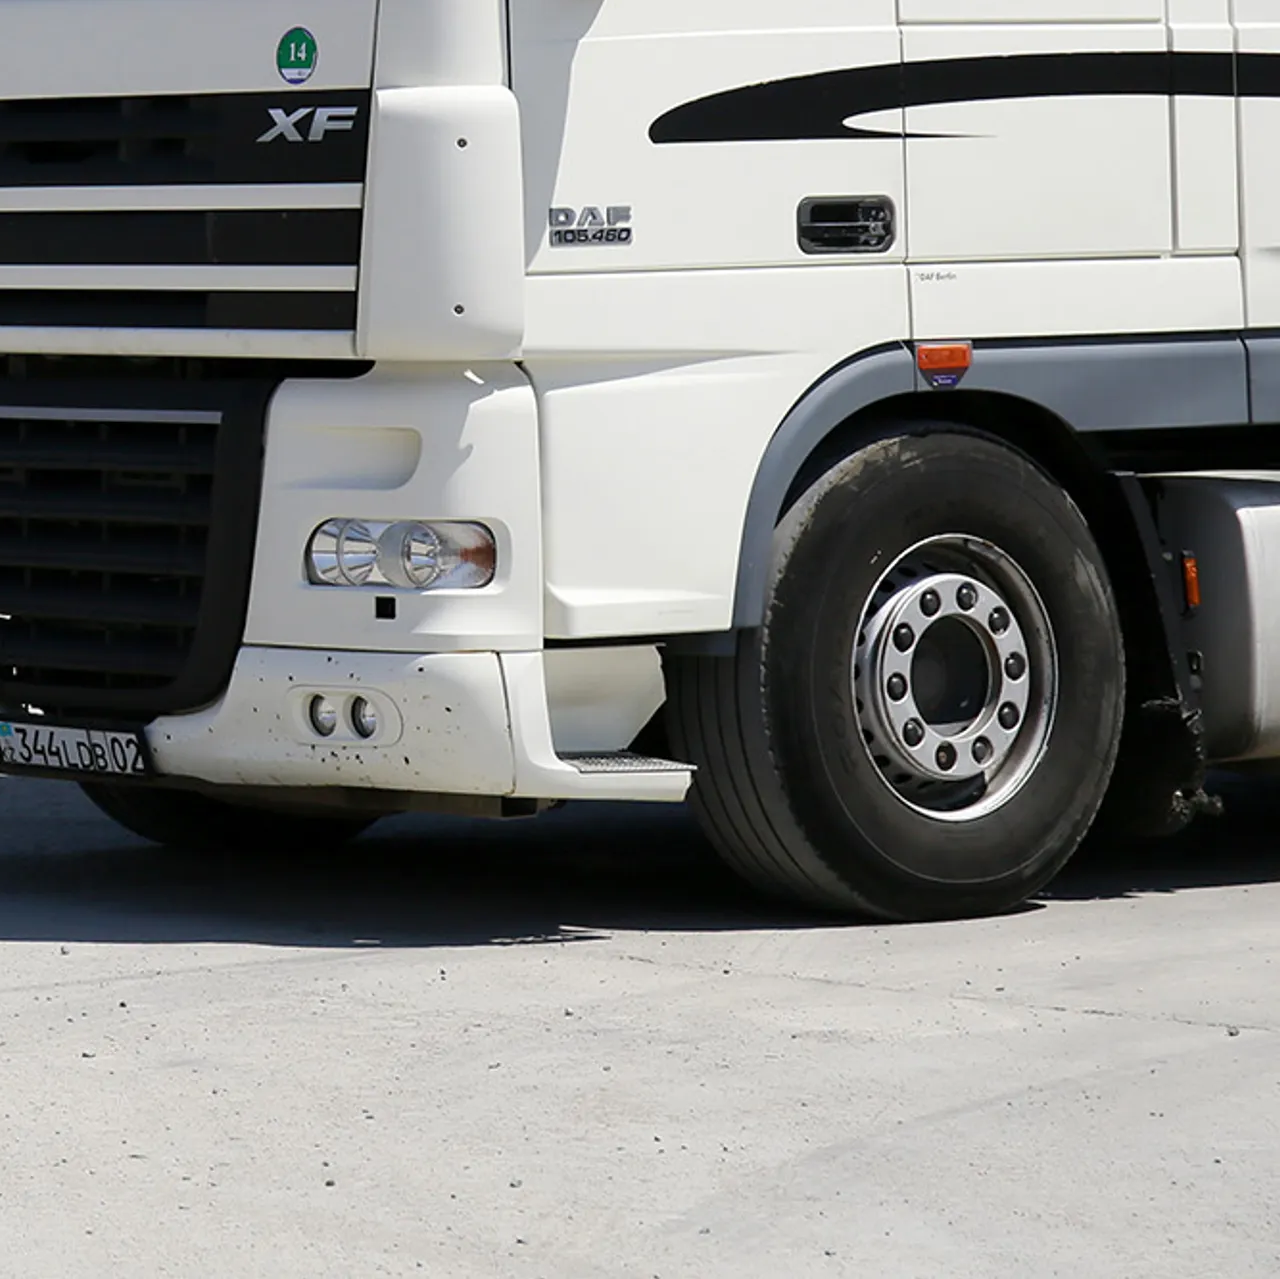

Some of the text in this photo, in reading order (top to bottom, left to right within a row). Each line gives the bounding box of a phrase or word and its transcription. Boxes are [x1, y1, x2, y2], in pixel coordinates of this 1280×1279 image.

[289, 42, 307, 61] 14
[256, 106, 359, 142] XF
[549, 206, 631, 226] DAF
[554, 228, 631, 243] 105.460
[15, 727, 63, 766] 344
[110, 736, 144, 774] 02
